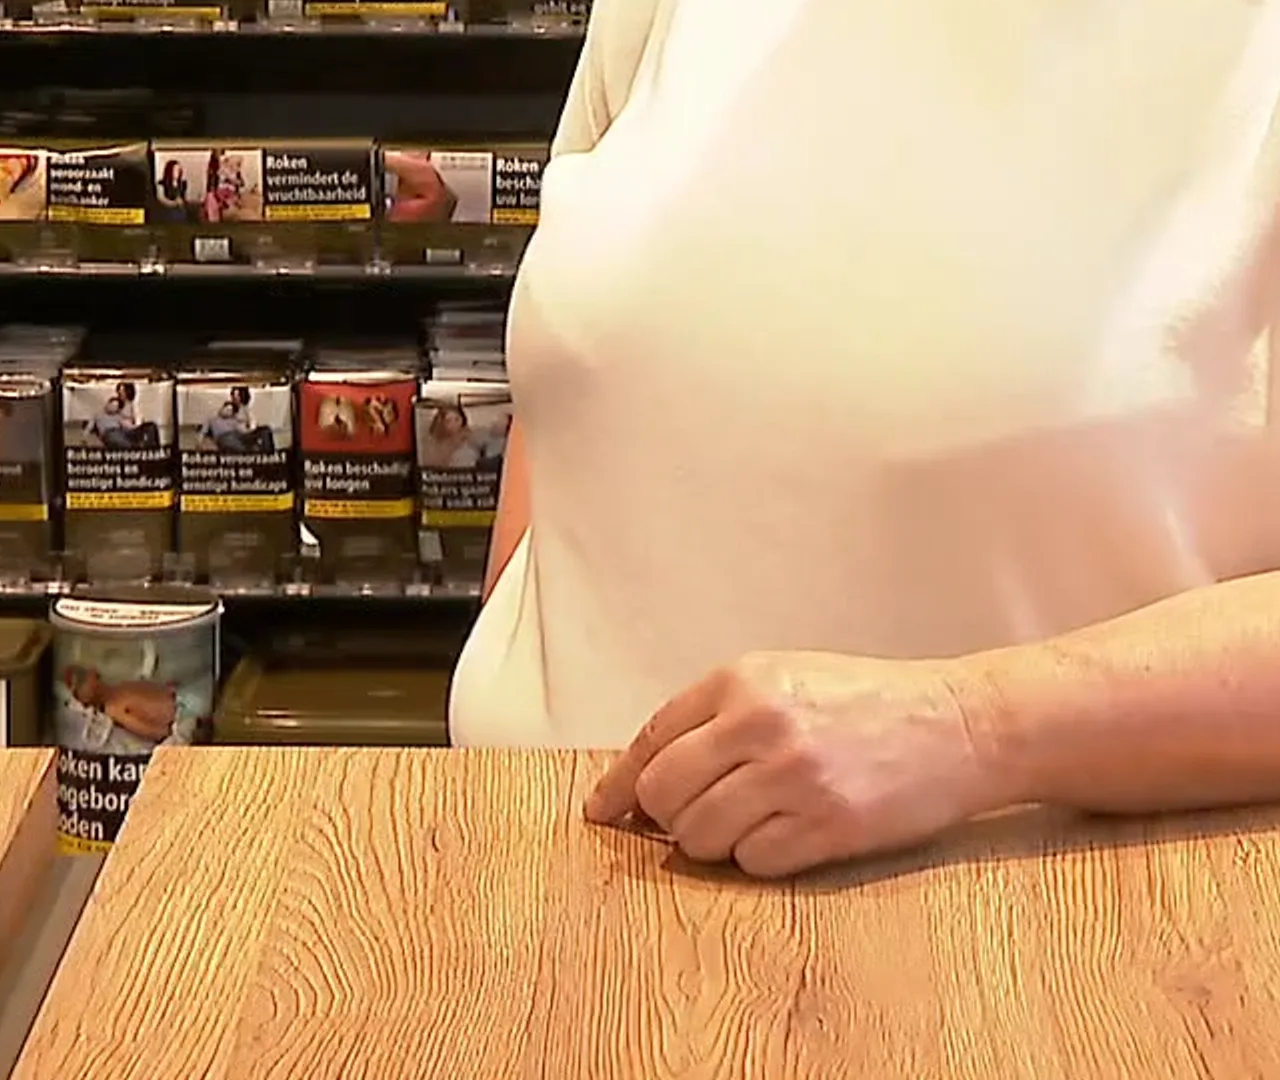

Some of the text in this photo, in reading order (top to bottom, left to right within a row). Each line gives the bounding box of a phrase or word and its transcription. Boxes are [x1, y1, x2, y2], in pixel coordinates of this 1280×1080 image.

[266, 155, 308, 170] Roken
[266, 170, 359, 186] vermindert de
[266, 186, 366, 202] vruchtbaarheid
[59, 751, 101, 780] oken
[61, 813, 104, 840] oden
